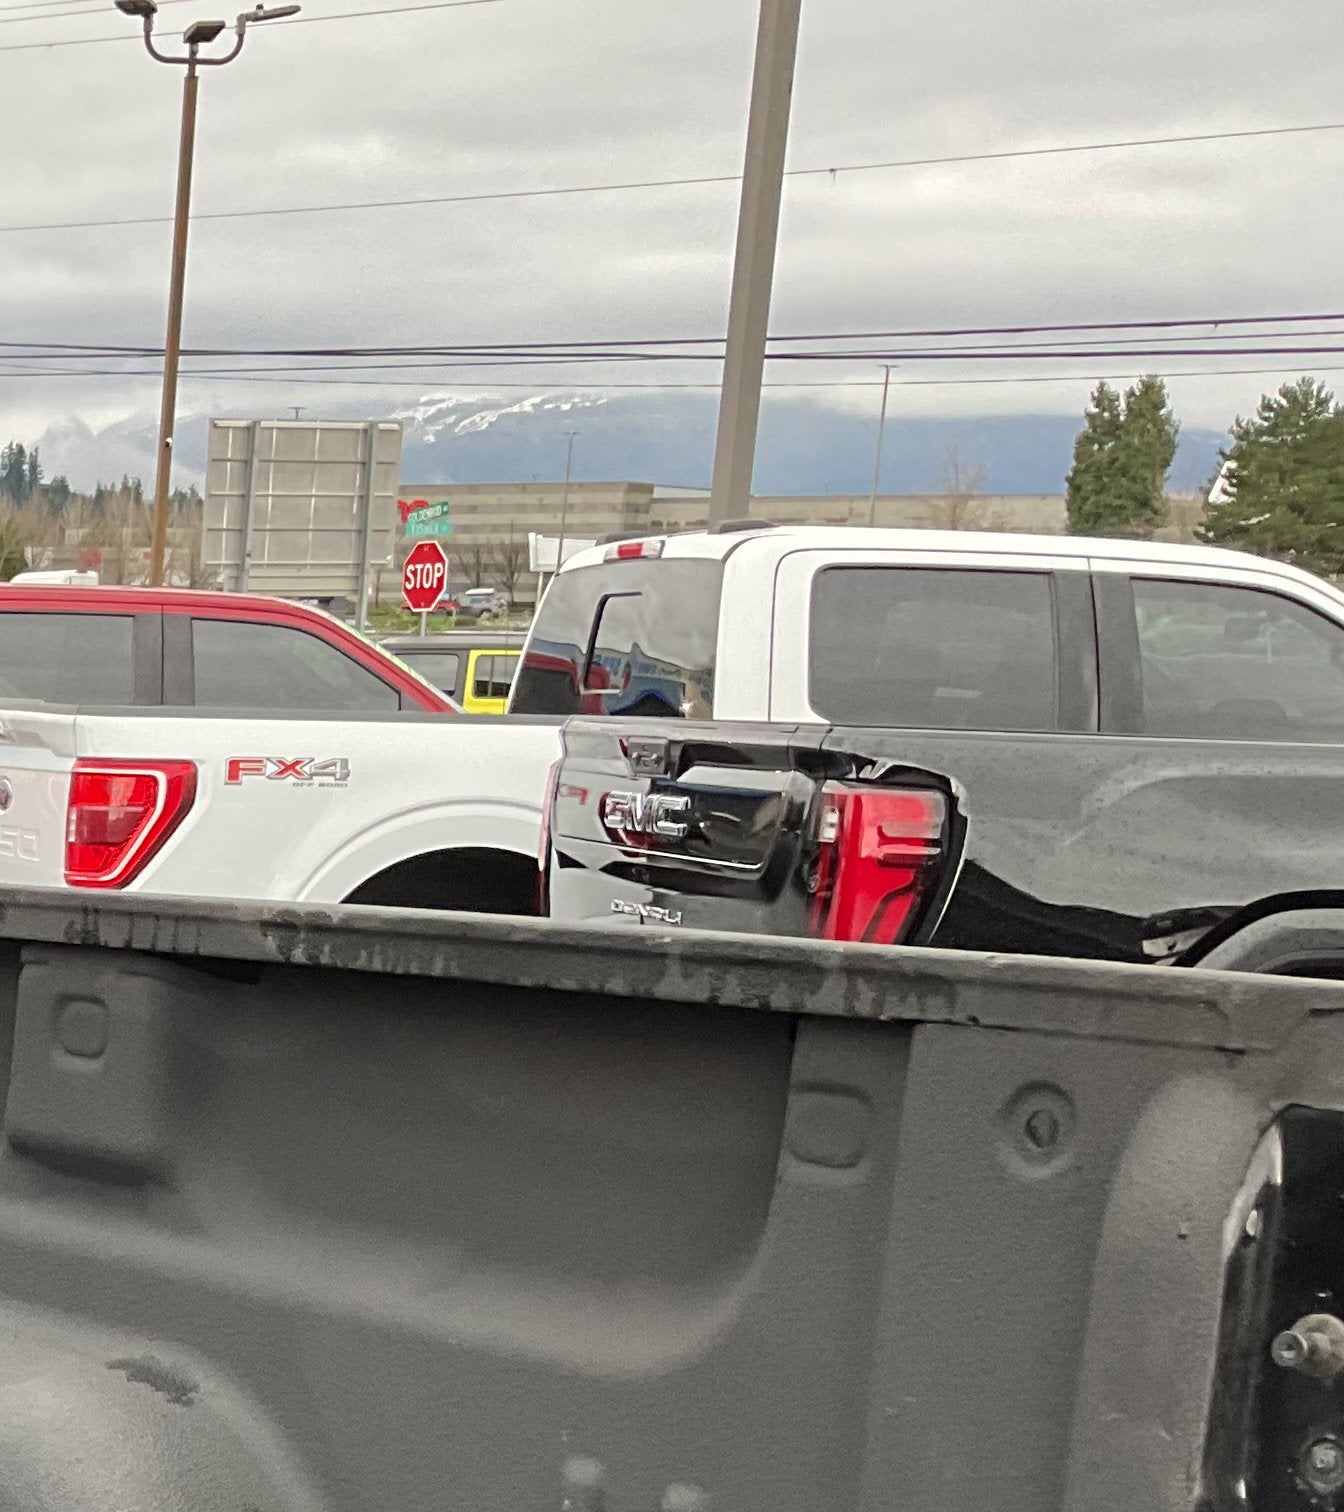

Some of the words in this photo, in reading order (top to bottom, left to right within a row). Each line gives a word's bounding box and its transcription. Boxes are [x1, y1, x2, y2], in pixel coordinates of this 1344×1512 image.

[405, 562, 444, 590] STOP
[224, 757, 351, 786] FX4
[603, 790, 692, 837] GMC
